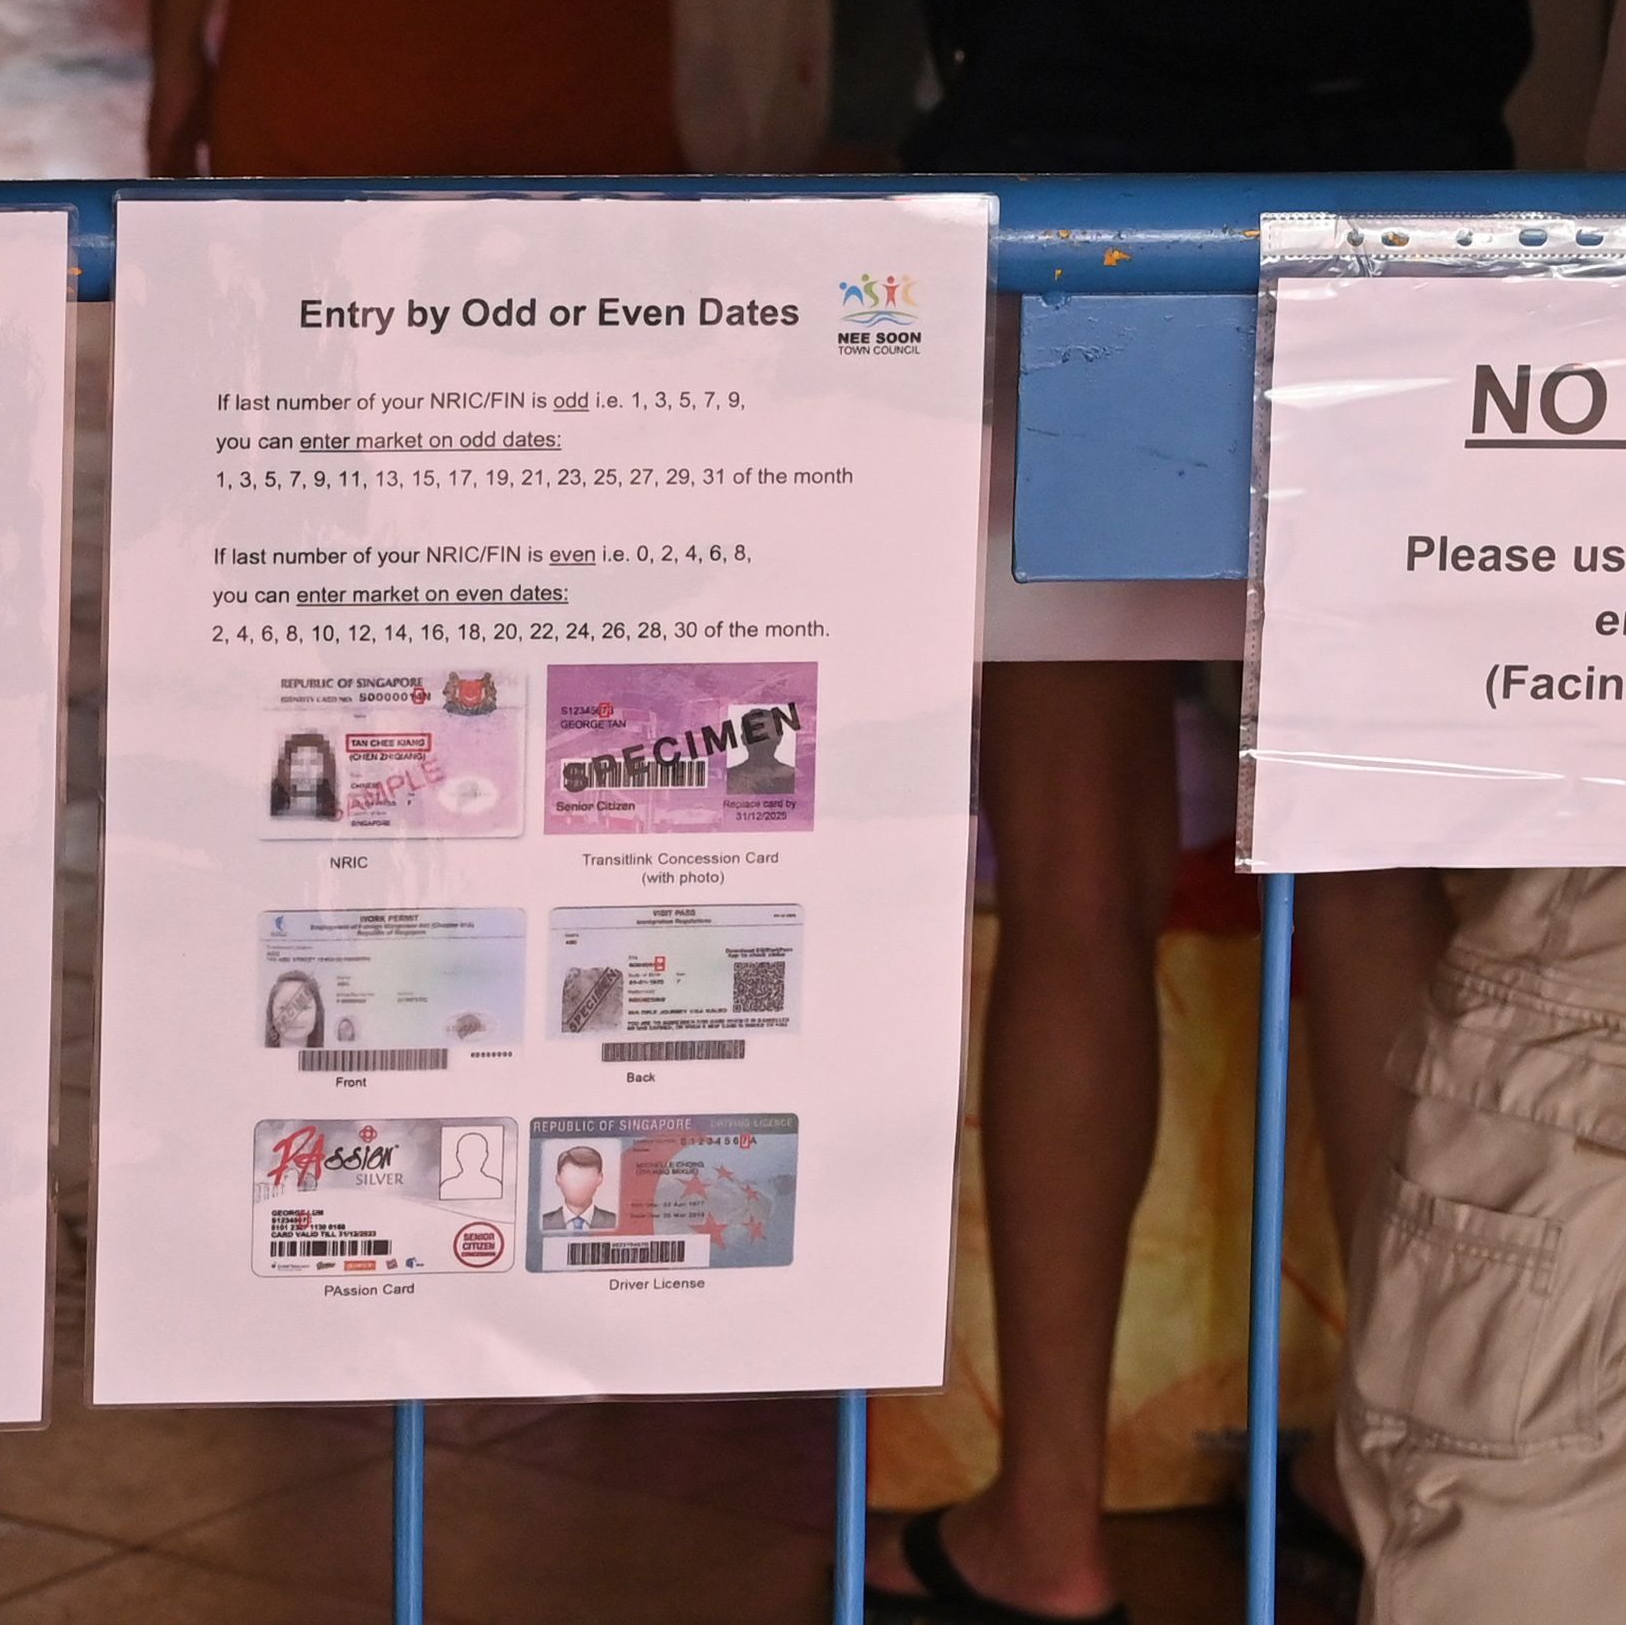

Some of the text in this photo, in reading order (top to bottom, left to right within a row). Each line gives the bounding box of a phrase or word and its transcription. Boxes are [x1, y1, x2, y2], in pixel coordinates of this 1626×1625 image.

[300, 297, 800, 336] Entry by Odd or Even Dates
[837, 331, 922, 345] NEE SOON
[838, 345, 921, 356] TOWN COUNCIL
[218, 391, 745, 415] If last number of your NRIC/FIN is odd i.e. 1, 3, 5, 7, 9,
[1471, 362, 1608, 450] NO
[216, 430, 561, 455] you can enter market on odd dates:
[214, 544, 751, 568] If last number of your NRIC/FIN is even i.e. 0, 2, 4, 6, 8,
[1406, 535, 1556, 573] Please
[212, 584, 568, 608] you can enter market on even dates:
[280, 677, 424, 689] REPUBLIC OF SINGAPORE
[562, 702, 802, 793] SPECIMEN
[330, 856, 368, 869] NRIC
[582, 851, 779, 866] Transitlink Concession Card
[641, 871, 725, 887] (with photo)
[335, 1076, 367, 1088] Front
[626, 1071, 656, 1083] Back
[533, 1118, 692, 1133] REPUBLIC OF SINGAPORE
[355, 1172, 404, 1186] SILVER
[324, 1282, 415, 1297] PAssion Card
[609, 1278, 705, 1291] Driver License
